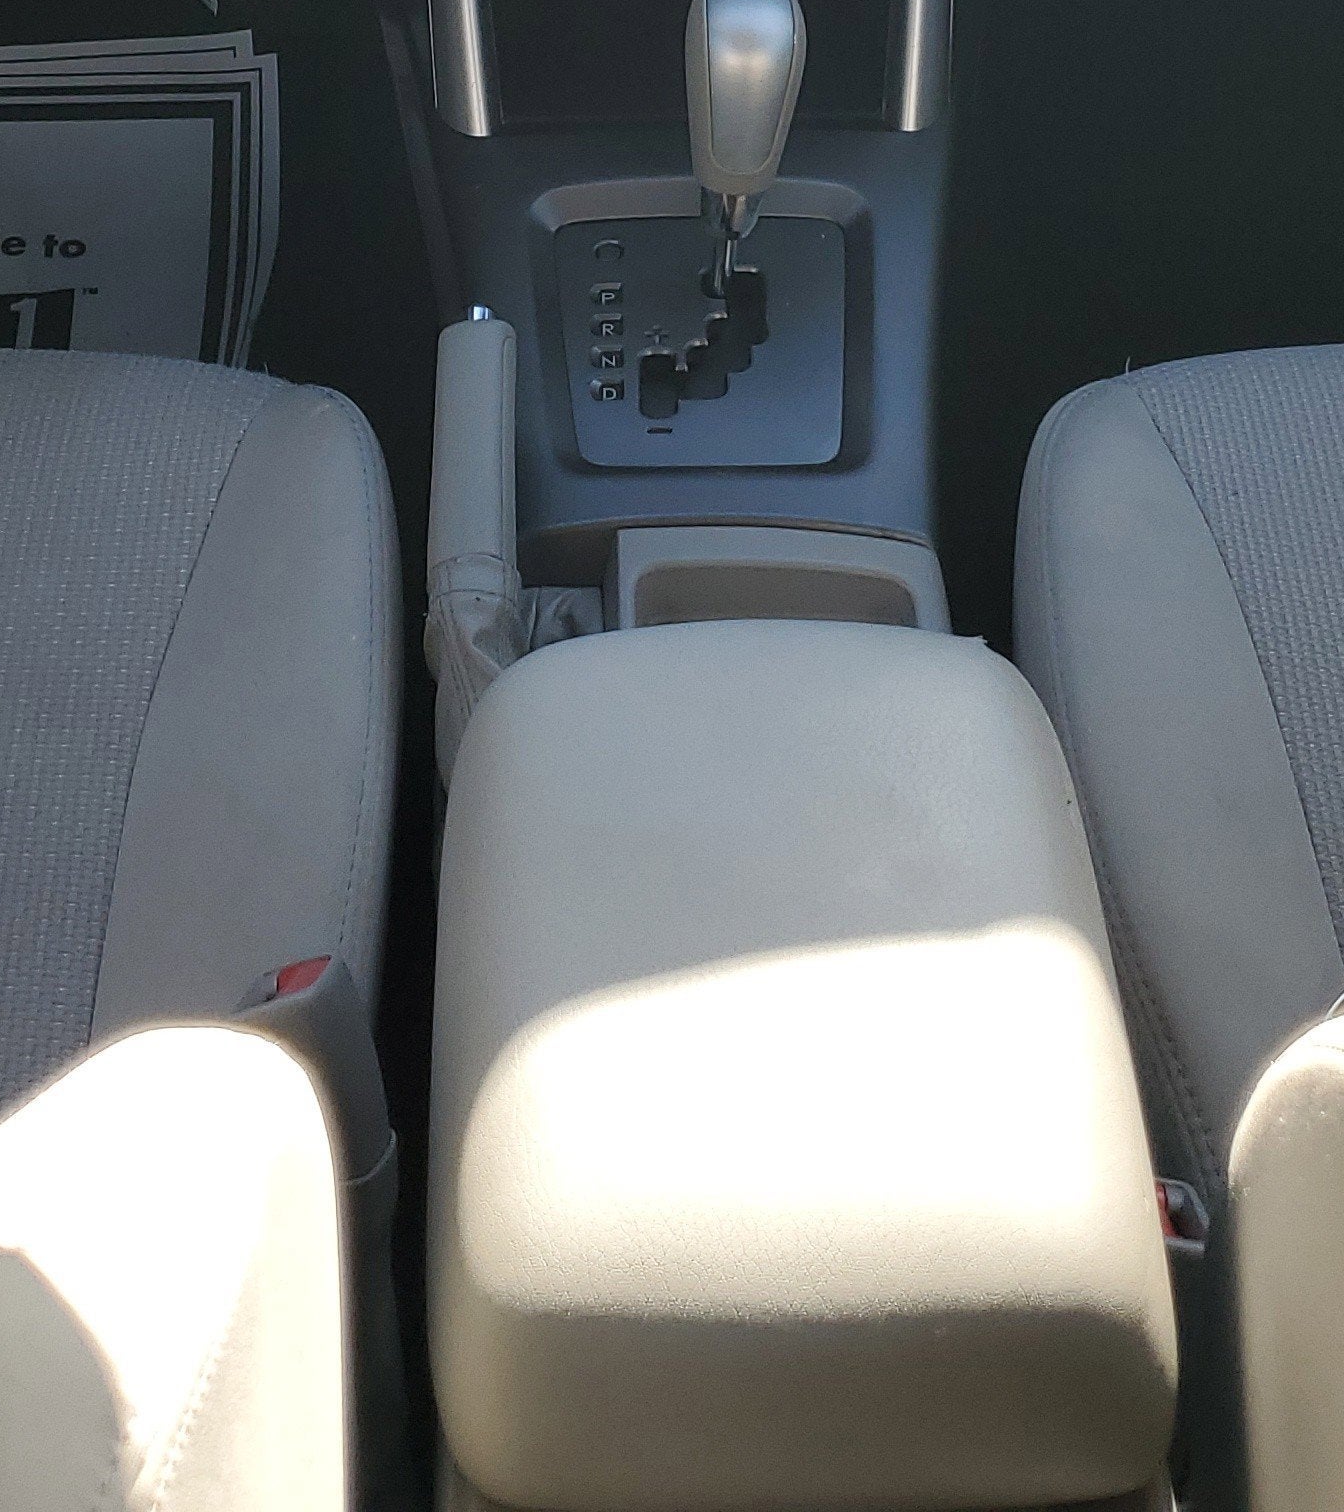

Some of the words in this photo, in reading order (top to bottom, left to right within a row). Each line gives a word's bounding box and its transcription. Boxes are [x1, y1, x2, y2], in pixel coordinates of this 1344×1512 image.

[43, 233, 87, 260] to
[601, 292, 615, 304] P
[602, 323, 615, 336] R
[602, 355, 616, 367] N
[602, 388, 617, 400] D
